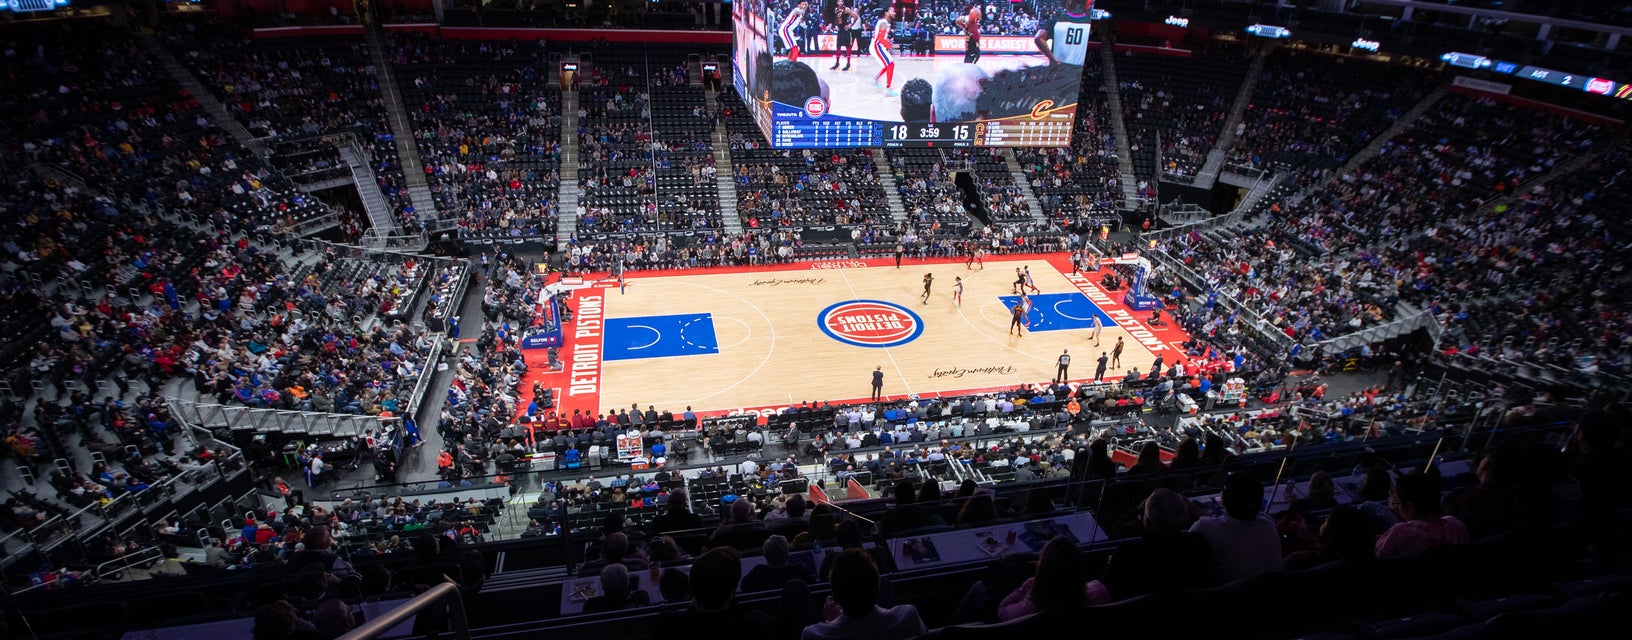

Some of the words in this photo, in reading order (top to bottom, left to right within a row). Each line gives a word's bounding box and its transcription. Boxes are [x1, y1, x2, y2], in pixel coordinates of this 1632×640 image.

[1165, 15, 1188, 28] Jeep
[988, 38, 1027, 48] EASIEST
[1065, 28, 1082, 45] 60
[1352, 38, 1380, 52] Jeep
[1561, 76, 1572, 85] 2
[890, 125, 908, 140] 18
[920, 128, 940, 138] 3:59
[952, 125, 969, 140] 15
[1064, 272, 1117, 305] DETROIT
[575, 296, 602, 339] PISTONS
[837, 313, 900, 324] PISTONS
[843, 322, 904, 332] DETROIT
[1107, 309, 1170, 350] PISTONS
[569, 344, 599, 396] DETROIT
[934, 366, 967, 378] Equity
[968, 366, 1015, 376] Platinum
